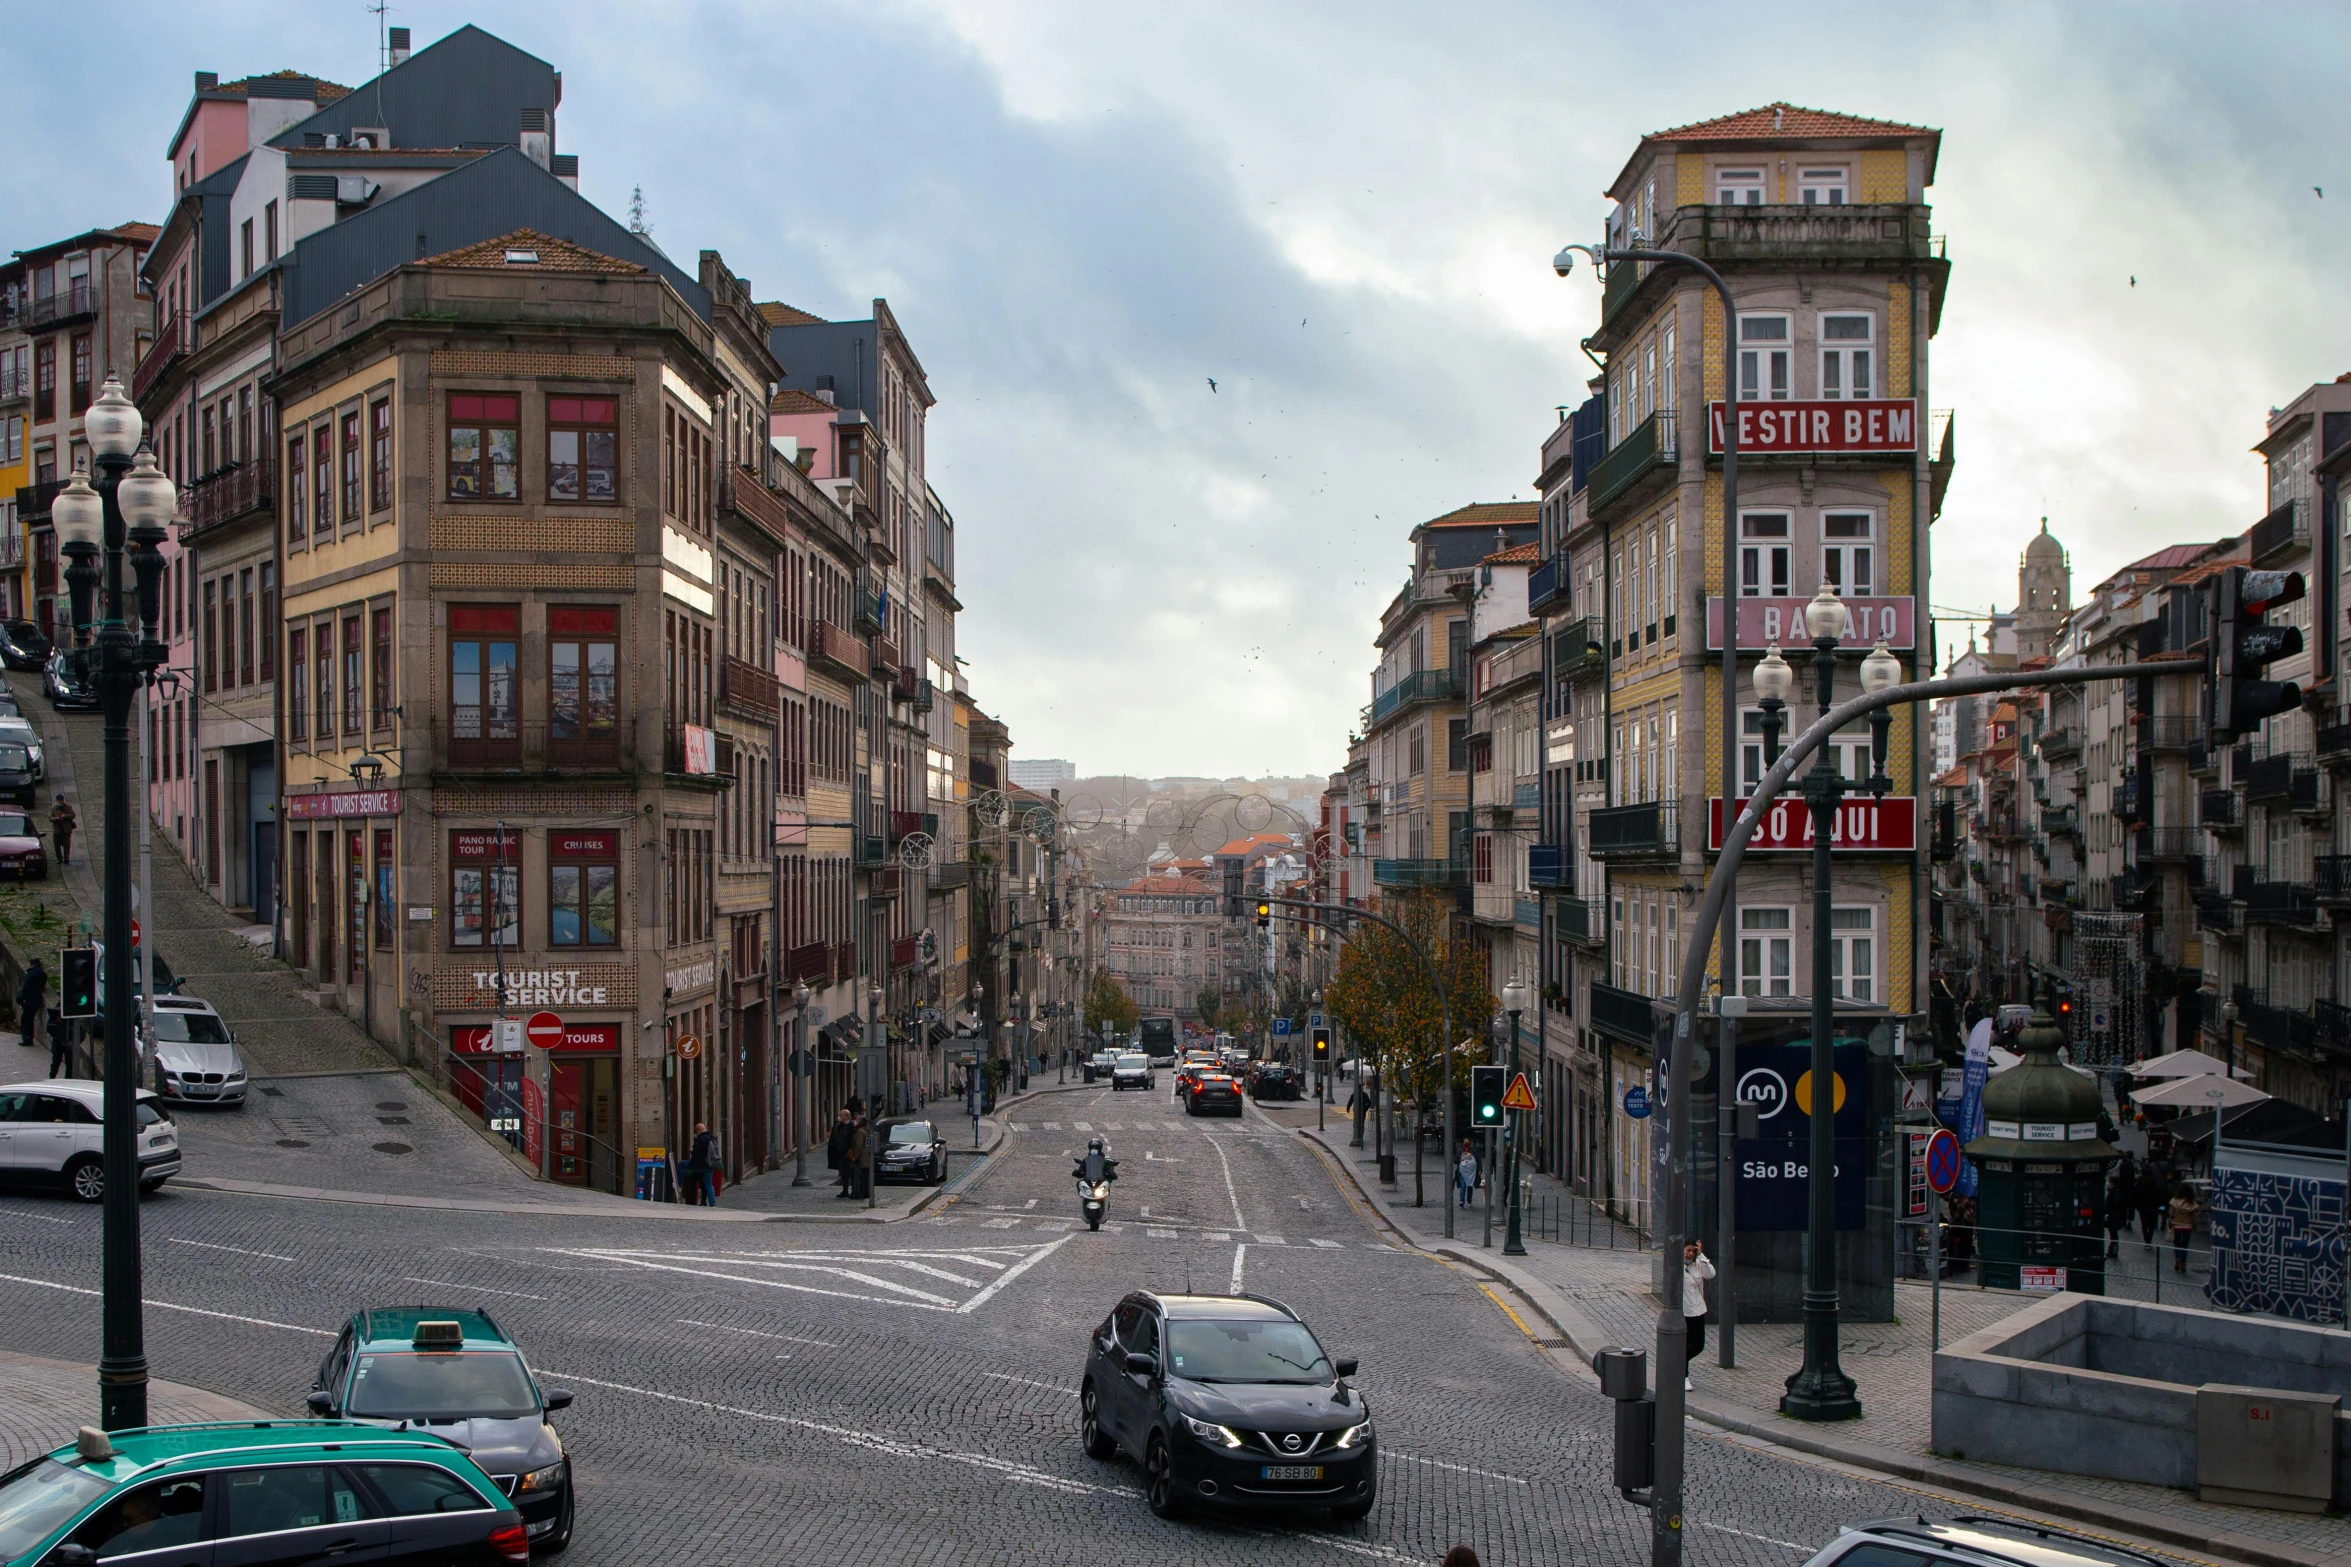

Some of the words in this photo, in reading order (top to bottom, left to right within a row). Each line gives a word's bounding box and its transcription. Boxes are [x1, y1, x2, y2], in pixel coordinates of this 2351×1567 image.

[1714, 409, 1830, 444] VESTIR
[1844, 408, 1911, 444] BEM
[1764, 606, 1897, 640] BAATO
[330, 795, 359, 814] TOURIST
[360, 793, 388, 812] SERVICE
[459, 846, 484, 854] TOUR
[472, 971, 580, 989] TOURIST
[666, 966, 692, 994] TOURIST
[692, 961, 714, 988] SERVICE
[504, 987, 607, 1006] SERVICE
[565, 1034, 604, 1043] TOURS
[1743, 1161, 1778, 1179] São
[1784, 1161, 1840, 1179] Beo
